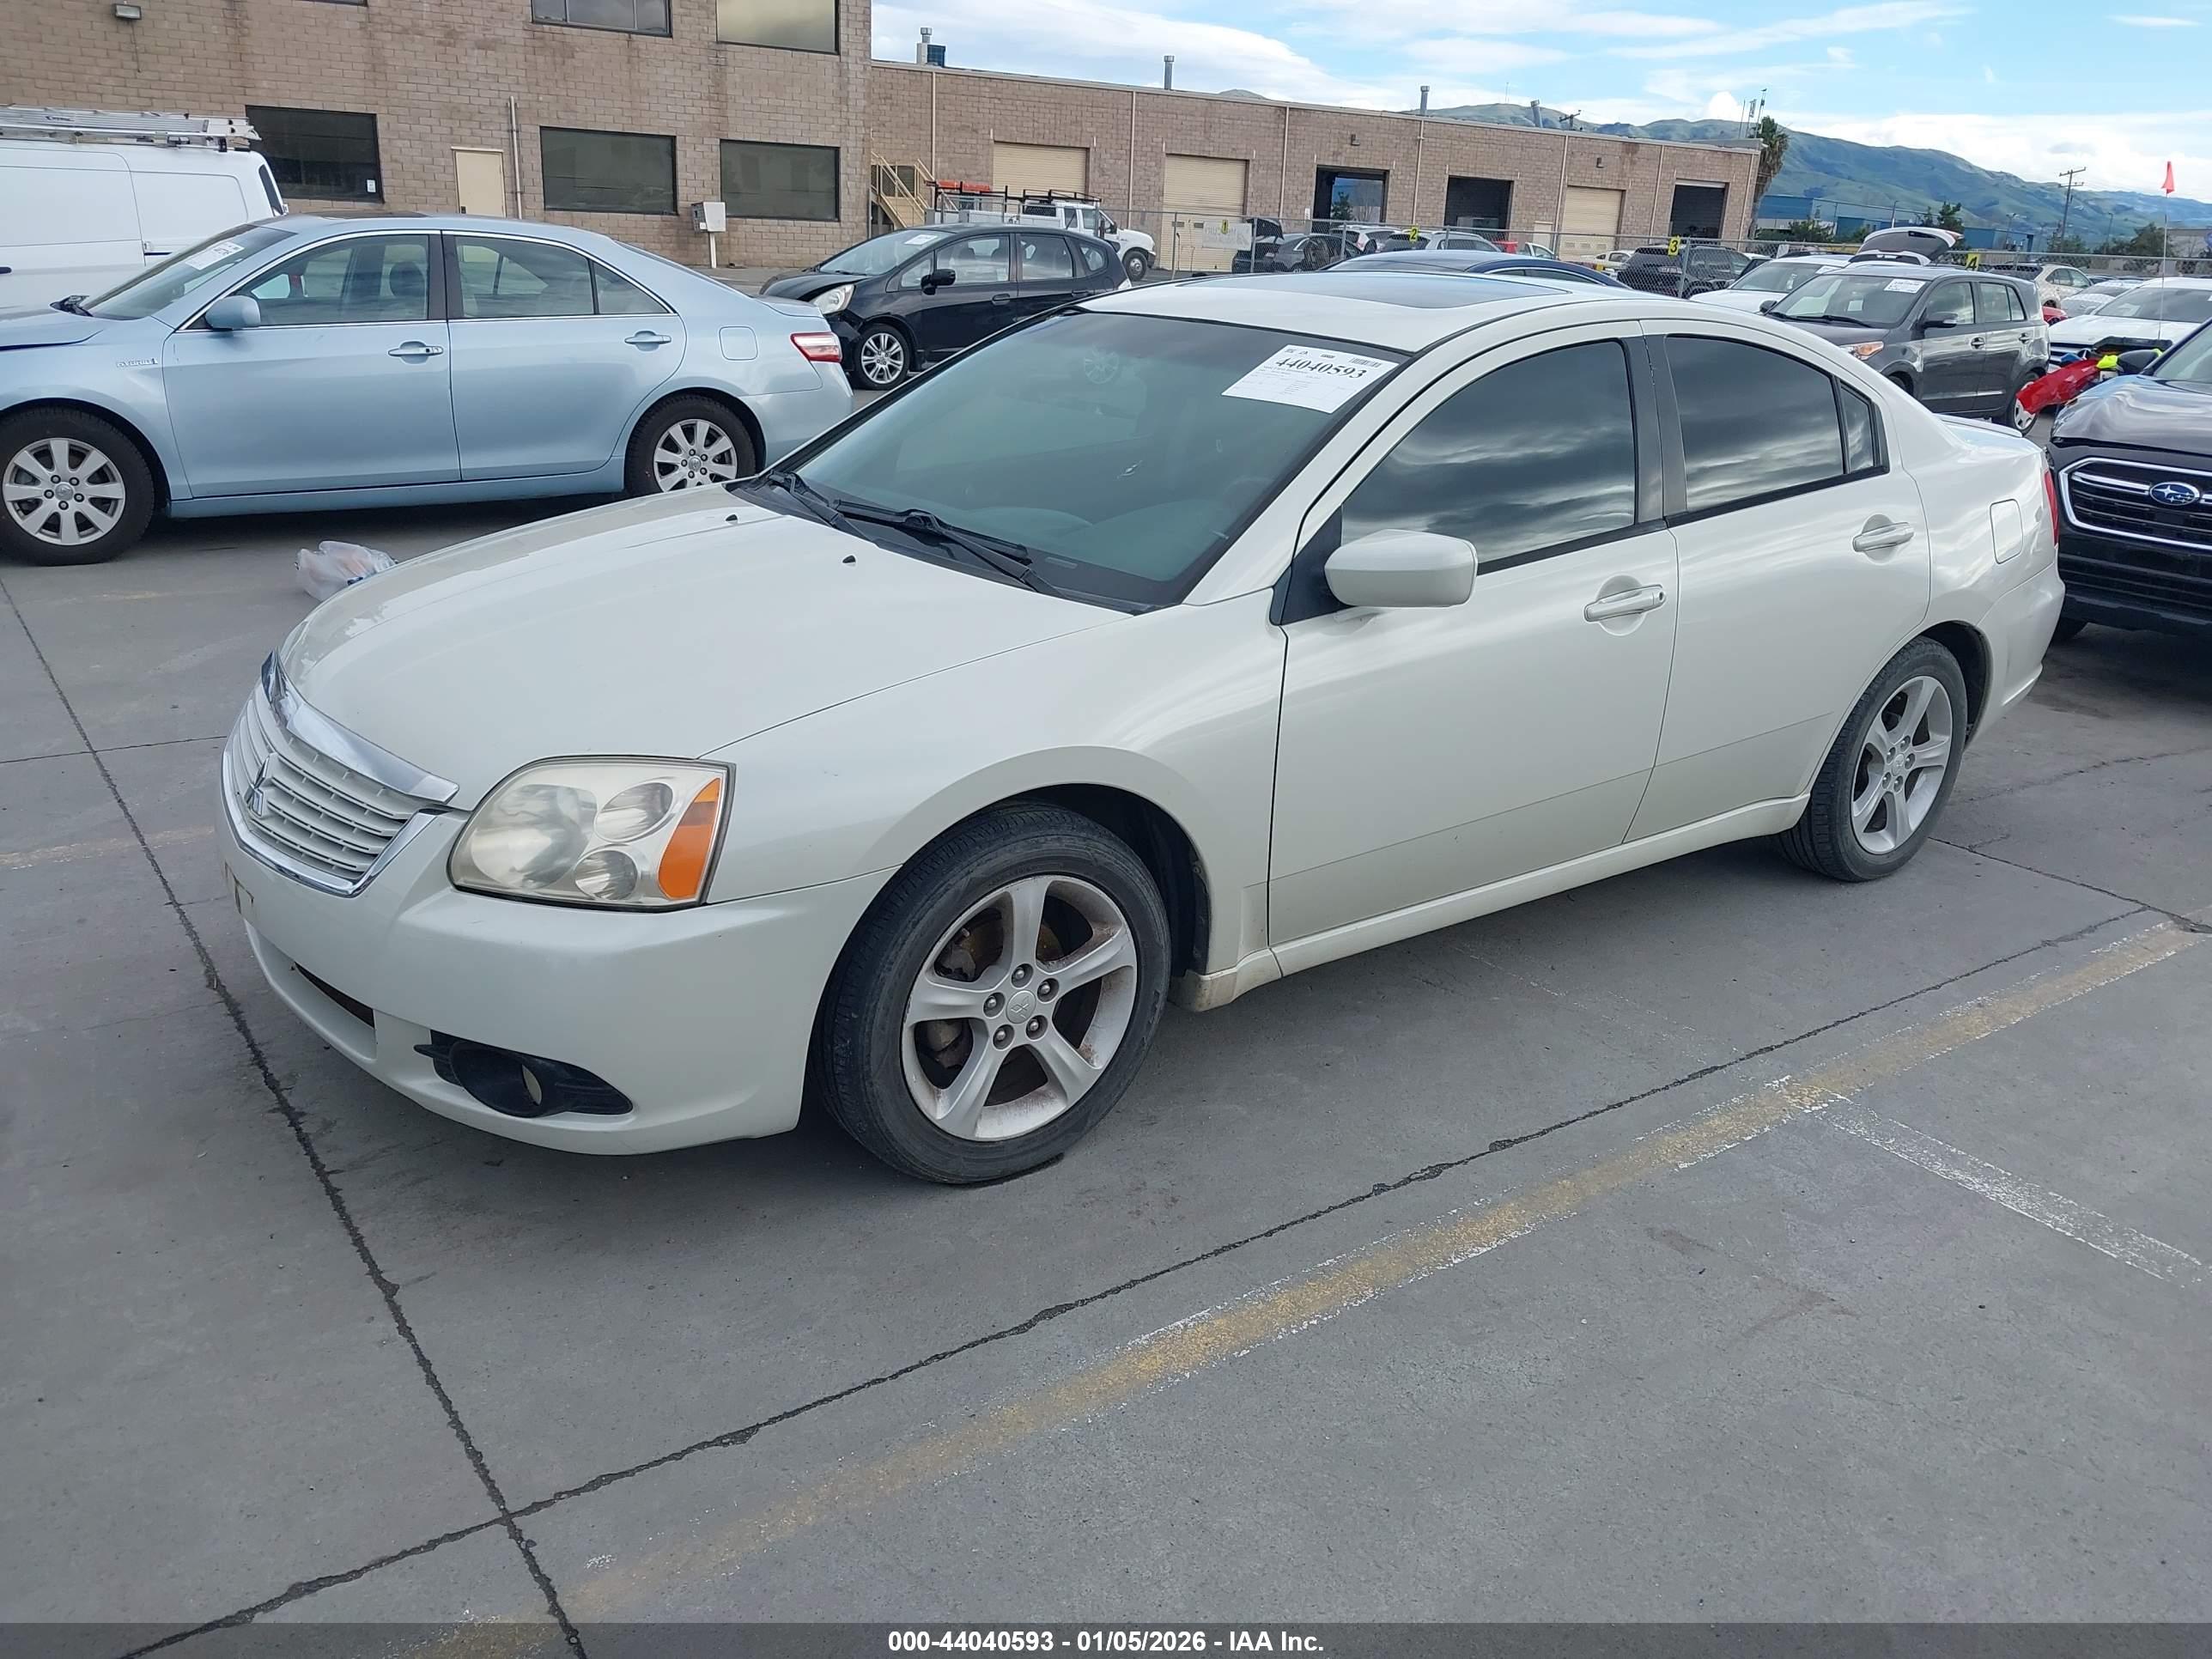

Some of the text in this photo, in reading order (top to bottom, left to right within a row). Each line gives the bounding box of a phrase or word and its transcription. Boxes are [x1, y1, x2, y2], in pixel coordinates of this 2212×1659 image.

[1410, 228, 1417, 240] 2
[1670, 240, 1679, 253] 3
[1966, 256, 1978, 270] 4
[1275, 357, 1367, 379] 44040593
